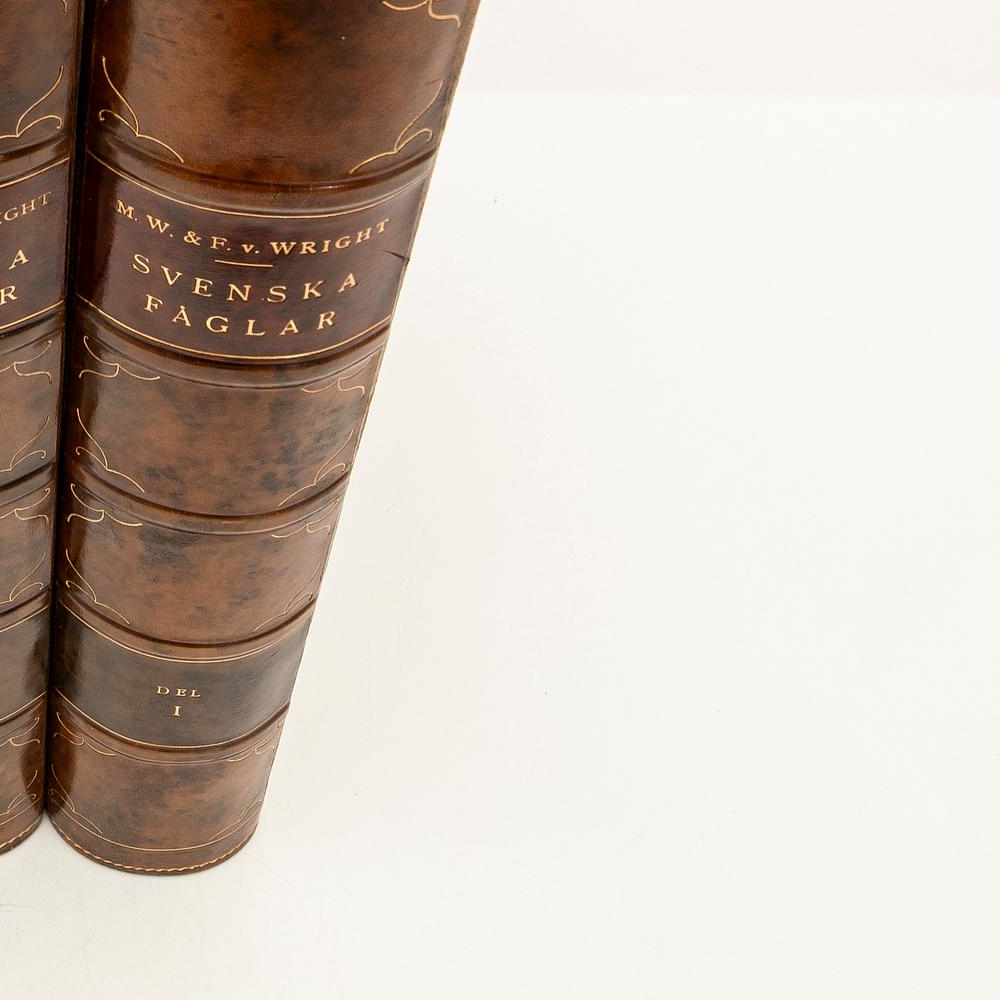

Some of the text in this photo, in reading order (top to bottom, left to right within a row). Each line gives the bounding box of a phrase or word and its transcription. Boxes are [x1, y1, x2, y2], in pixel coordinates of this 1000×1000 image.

[117, 200, 390, 256] M. W. & F. v. WRIGHT
[132, 254, 358, 304] SVENSKA
[144, 294, 336, 337] FÅGLAR
[156, 686, 201, 698] DEL
[173, 705, 182, 717] I
